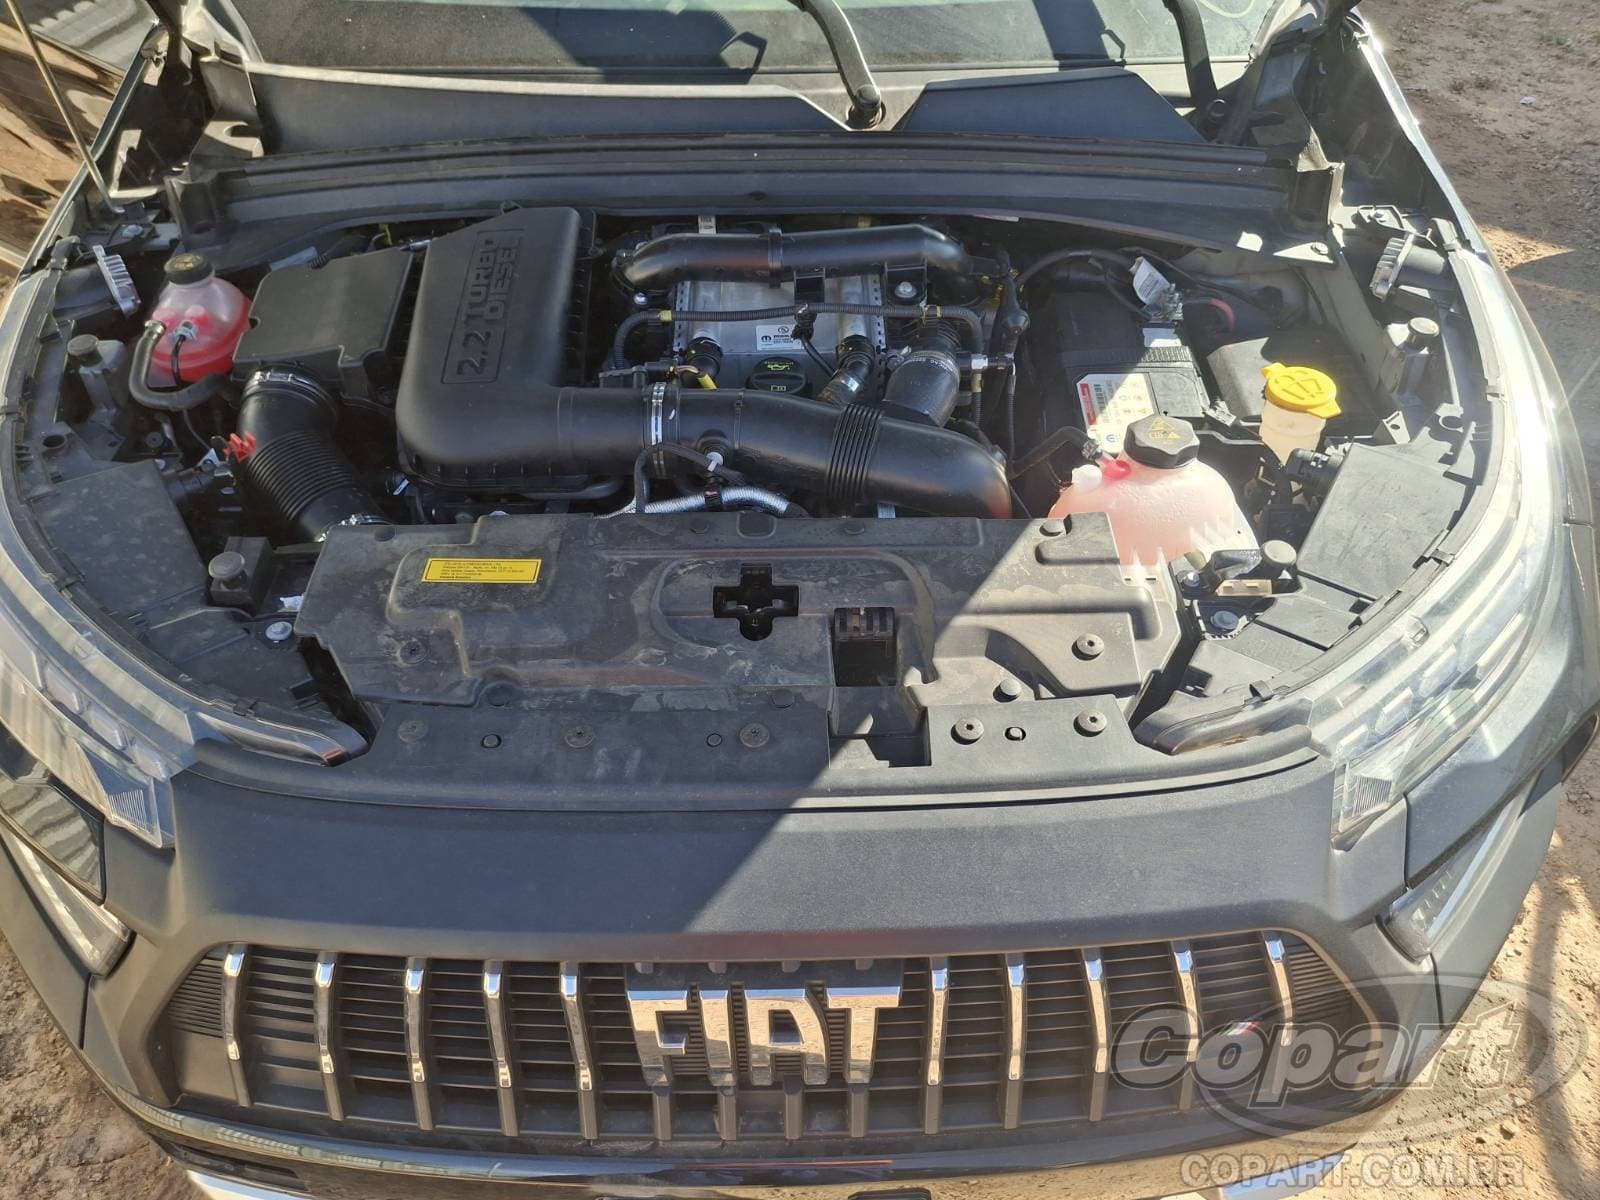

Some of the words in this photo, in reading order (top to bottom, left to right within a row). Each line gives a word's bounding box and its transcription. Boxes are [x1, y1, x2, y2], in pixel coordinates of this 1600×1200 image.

[464, 236, 498, 321] TURBO
[484, 235, 520, 321] DIESEL
[457, 330, 491, 375] 2.2
[627, 986, 902, 1086] FIAT
